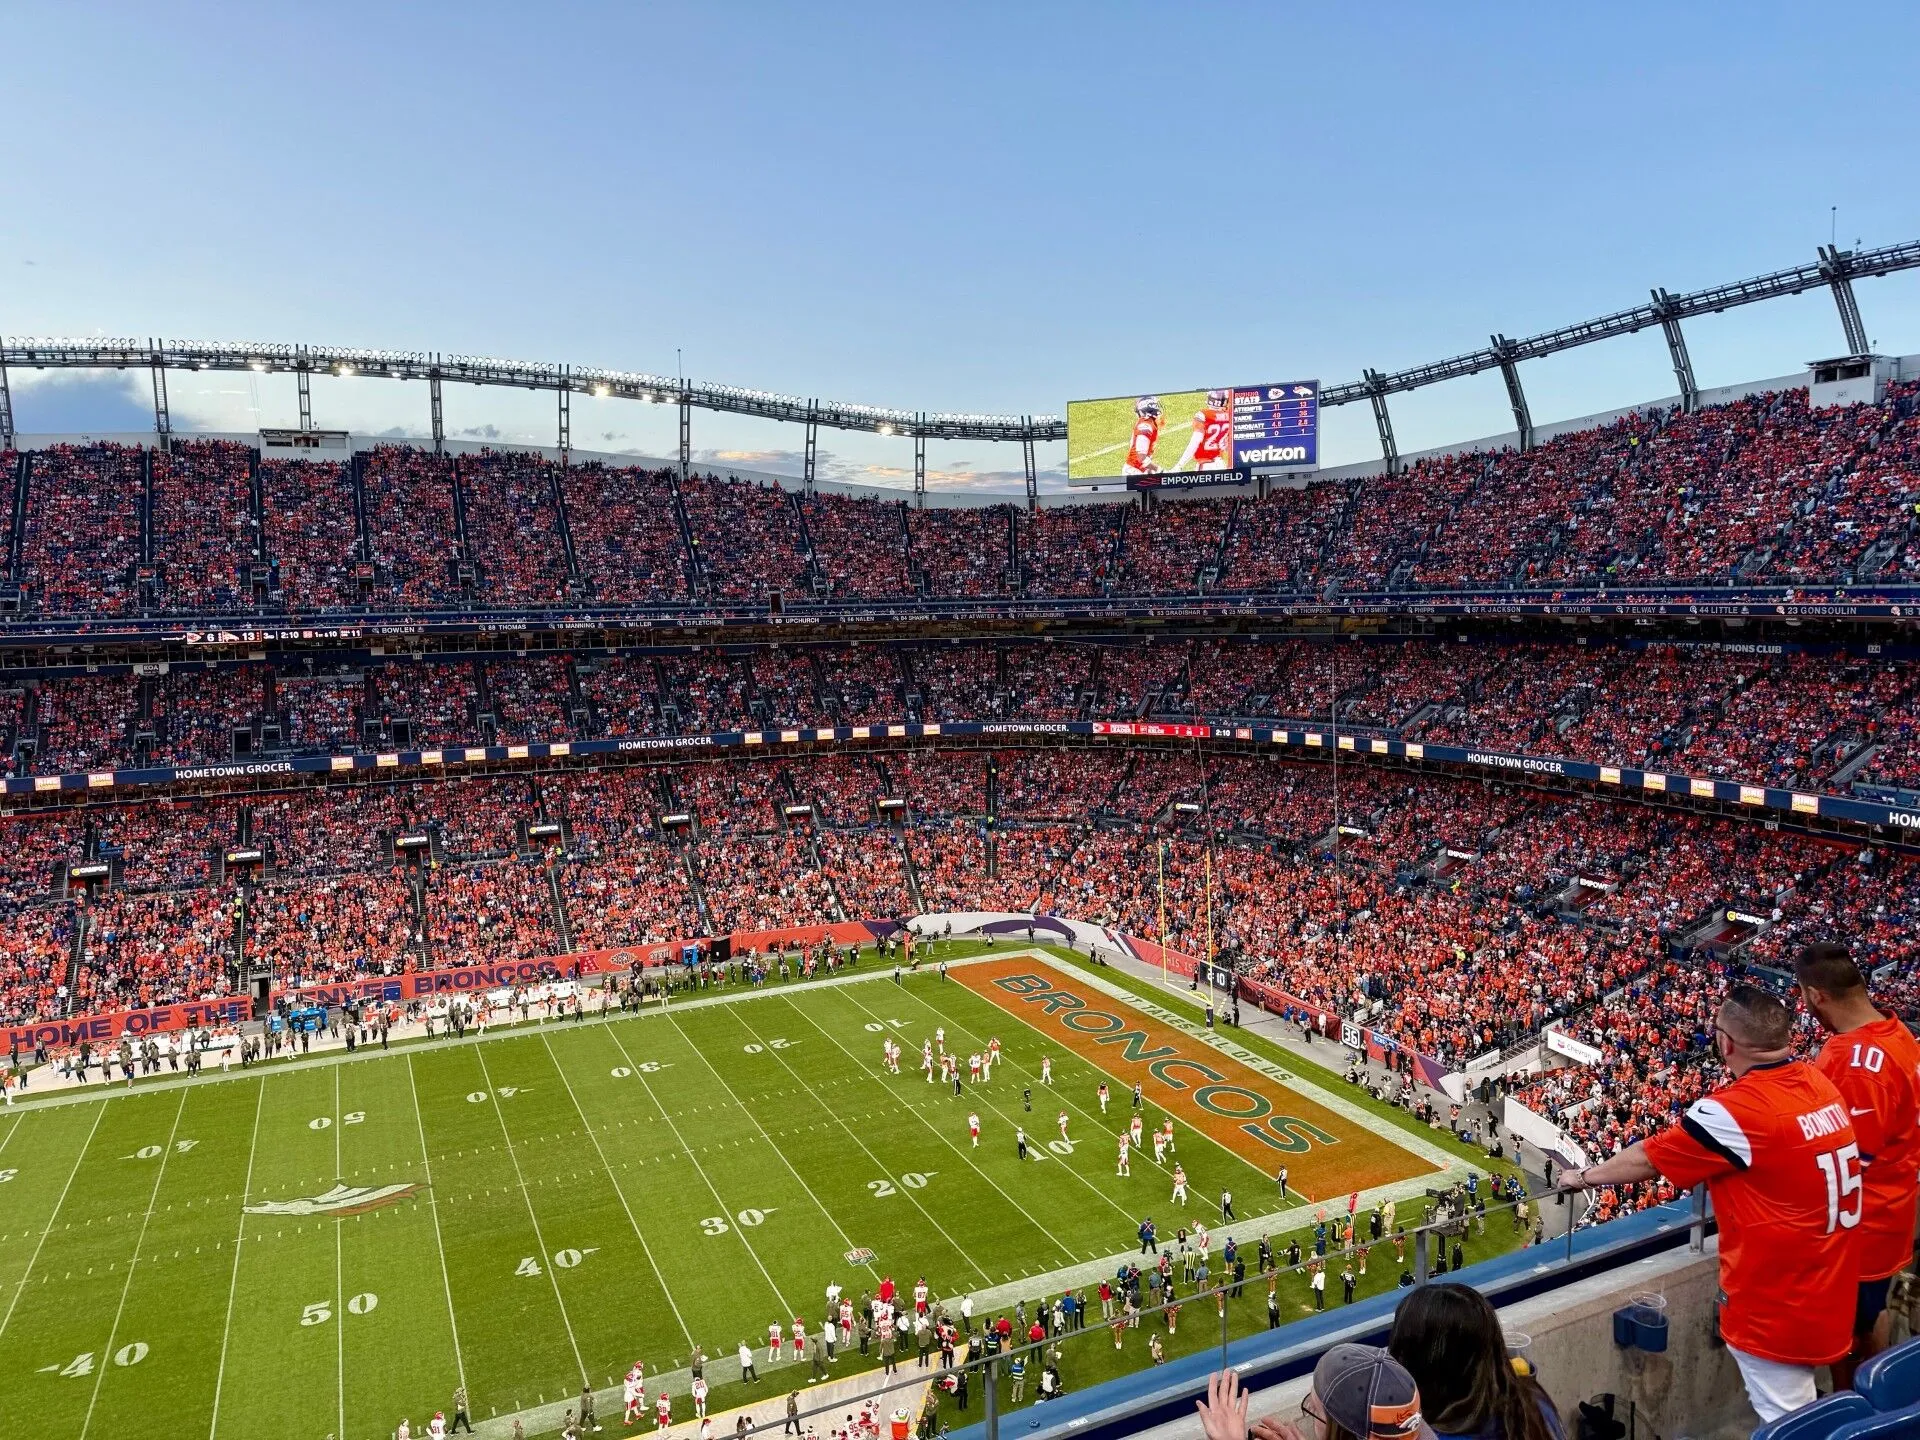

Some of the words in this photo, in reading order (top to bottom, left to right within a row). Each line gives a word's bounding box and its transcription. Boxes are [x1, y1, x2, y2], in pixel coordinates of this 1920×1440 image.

[1239, 445, 1306, 463] verizon
[1161, 474, 1212, 485] EMPOWER
[1214, 472, 1243, 482] FIELD
[1800, 606, 1857, 615] GONSOULIN
[206, 633, 214, 642] 6
[242, 633, 255, 641] 13
[280, 631, 299, 639] 2:10
[328, 630, 337, 638] 10
[351, 629, 361, 637] 11
[381, 626, 415, 634] BOWLEN
[498, 623, 527, 631] THOMAS
[1756, 644, 1782, 654] CLUB
[982, 724, 1032, 733] HOMETOWN
[1033, 723, 1070, 732] GROCER.
[1215, 728, 1231, 737] 2:10
[618, 740, 674, 750] HOMETOWN
[674, 736, 715, 746] GROCER.
[175, 765, 244, 779] HOMETOWN
[246, 761, 295, 774] GROCER.
[1467, 752, 1522, 769] HOMETOWN
[1523, 758, 1565, 774] GROCER.
[9, 1017, 112, 1049] HOME
[125, 1009, 171, 1033] OF
[1344, 1026, 1359, 1046] 36
[1141, 1003, 1194, 1030] TAKES
[1194, 1030, 1230, 1050] ALL
[1231, 1050, 1263, 1066] OF
[1260, 1066, 1295, 1082] US
[1566, 1043, 1592, 1060] Chevron
[991, 973, 1341, 1155] BRONCOS
[1850, 1043, 1885, 1073] 10
[1796, 1103, 1850, 1142] BONITTO
[867, 1172, 929, 1198] 20
[1816, 1142, 1862, 1235] 15
[700, 1207, 766, 1236] 30
[515, 1257, 584, 1278] 40
[300, 1292, 379, 1327] 50
[59, 1341, 150, 1379] 40
